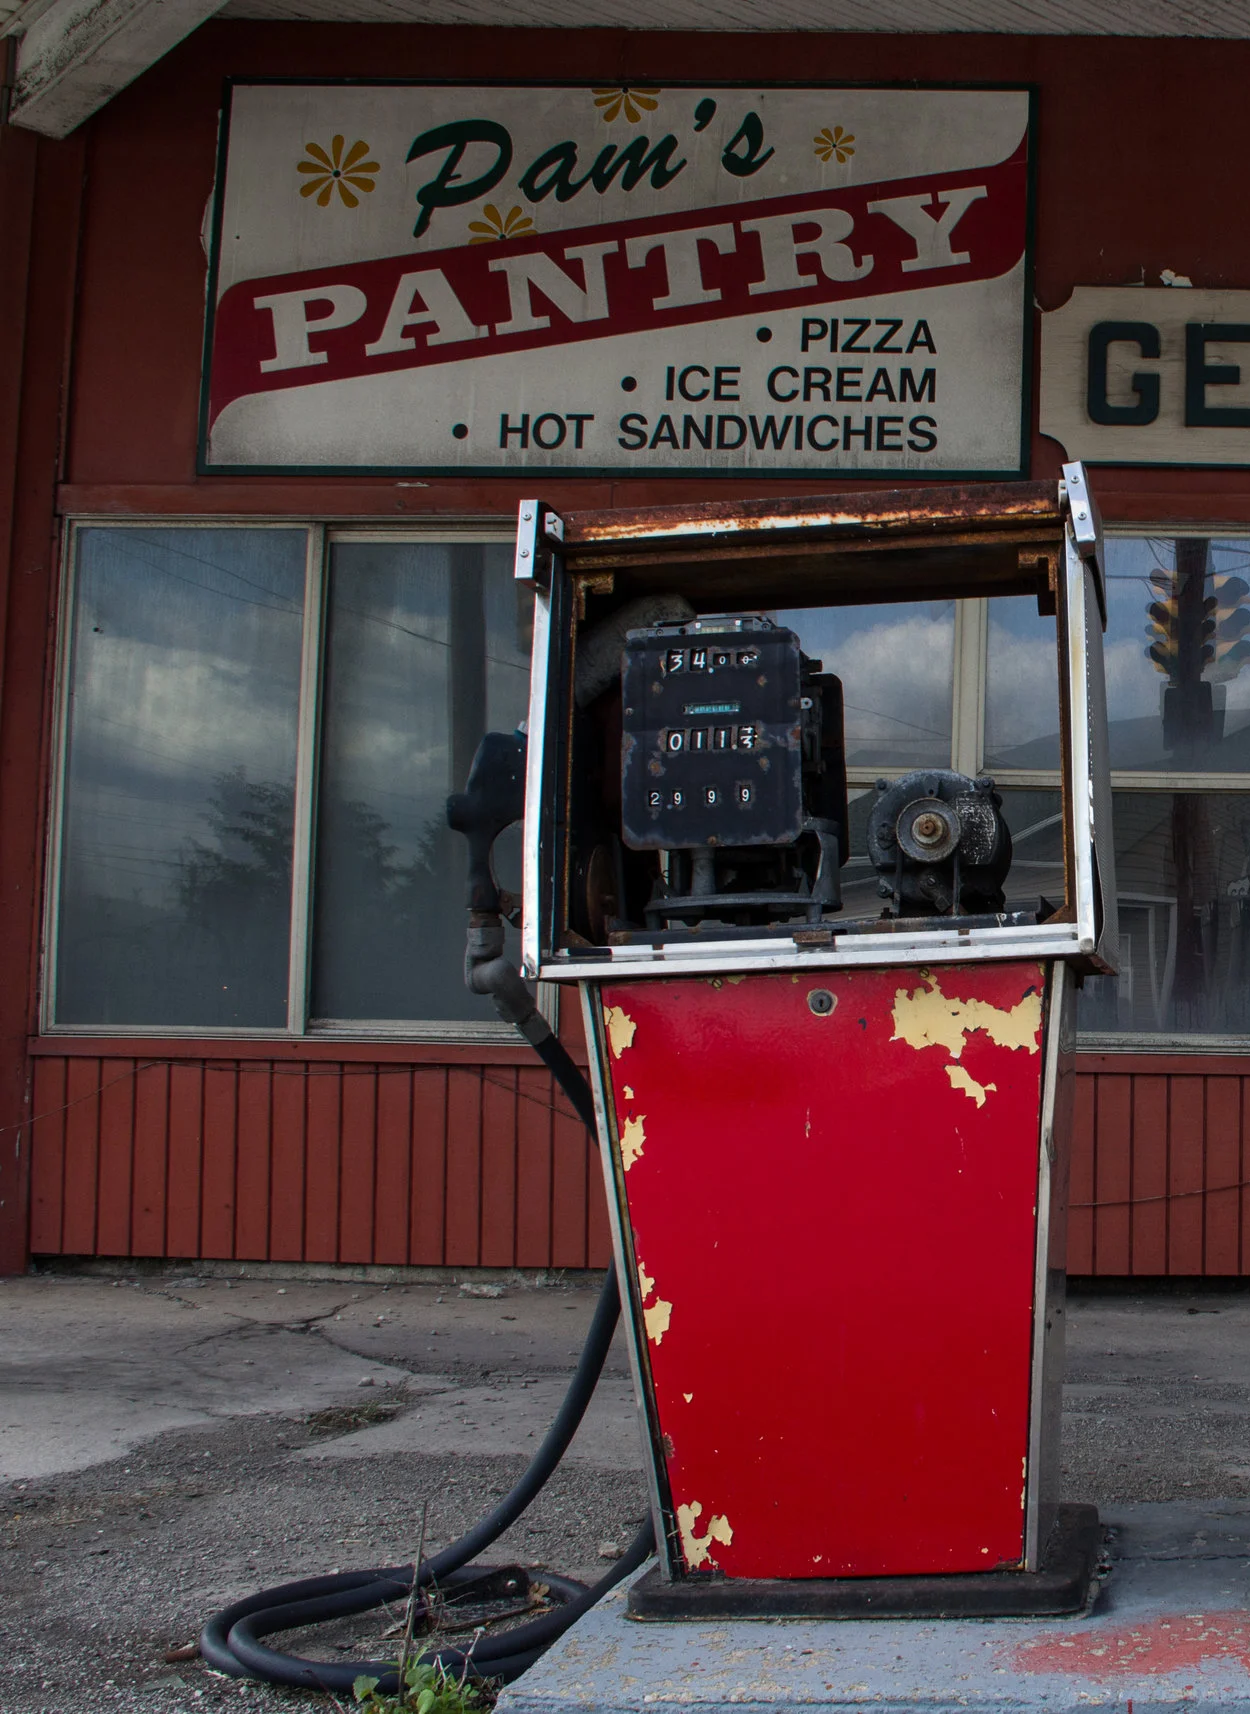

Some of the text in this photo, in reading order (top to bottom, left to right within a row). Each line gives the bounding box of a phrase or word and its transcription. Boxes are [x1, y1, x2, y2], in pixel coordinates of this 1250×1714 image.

[406, 98, 775, 237] Pam's
[253, 185, 989, 373] PANTRY
[800, 318, 937, 355] PIZZA
[665, 365, 937, 404] ICE CREAM
[499, 413, 938, 453] HOT SANDWICHES
